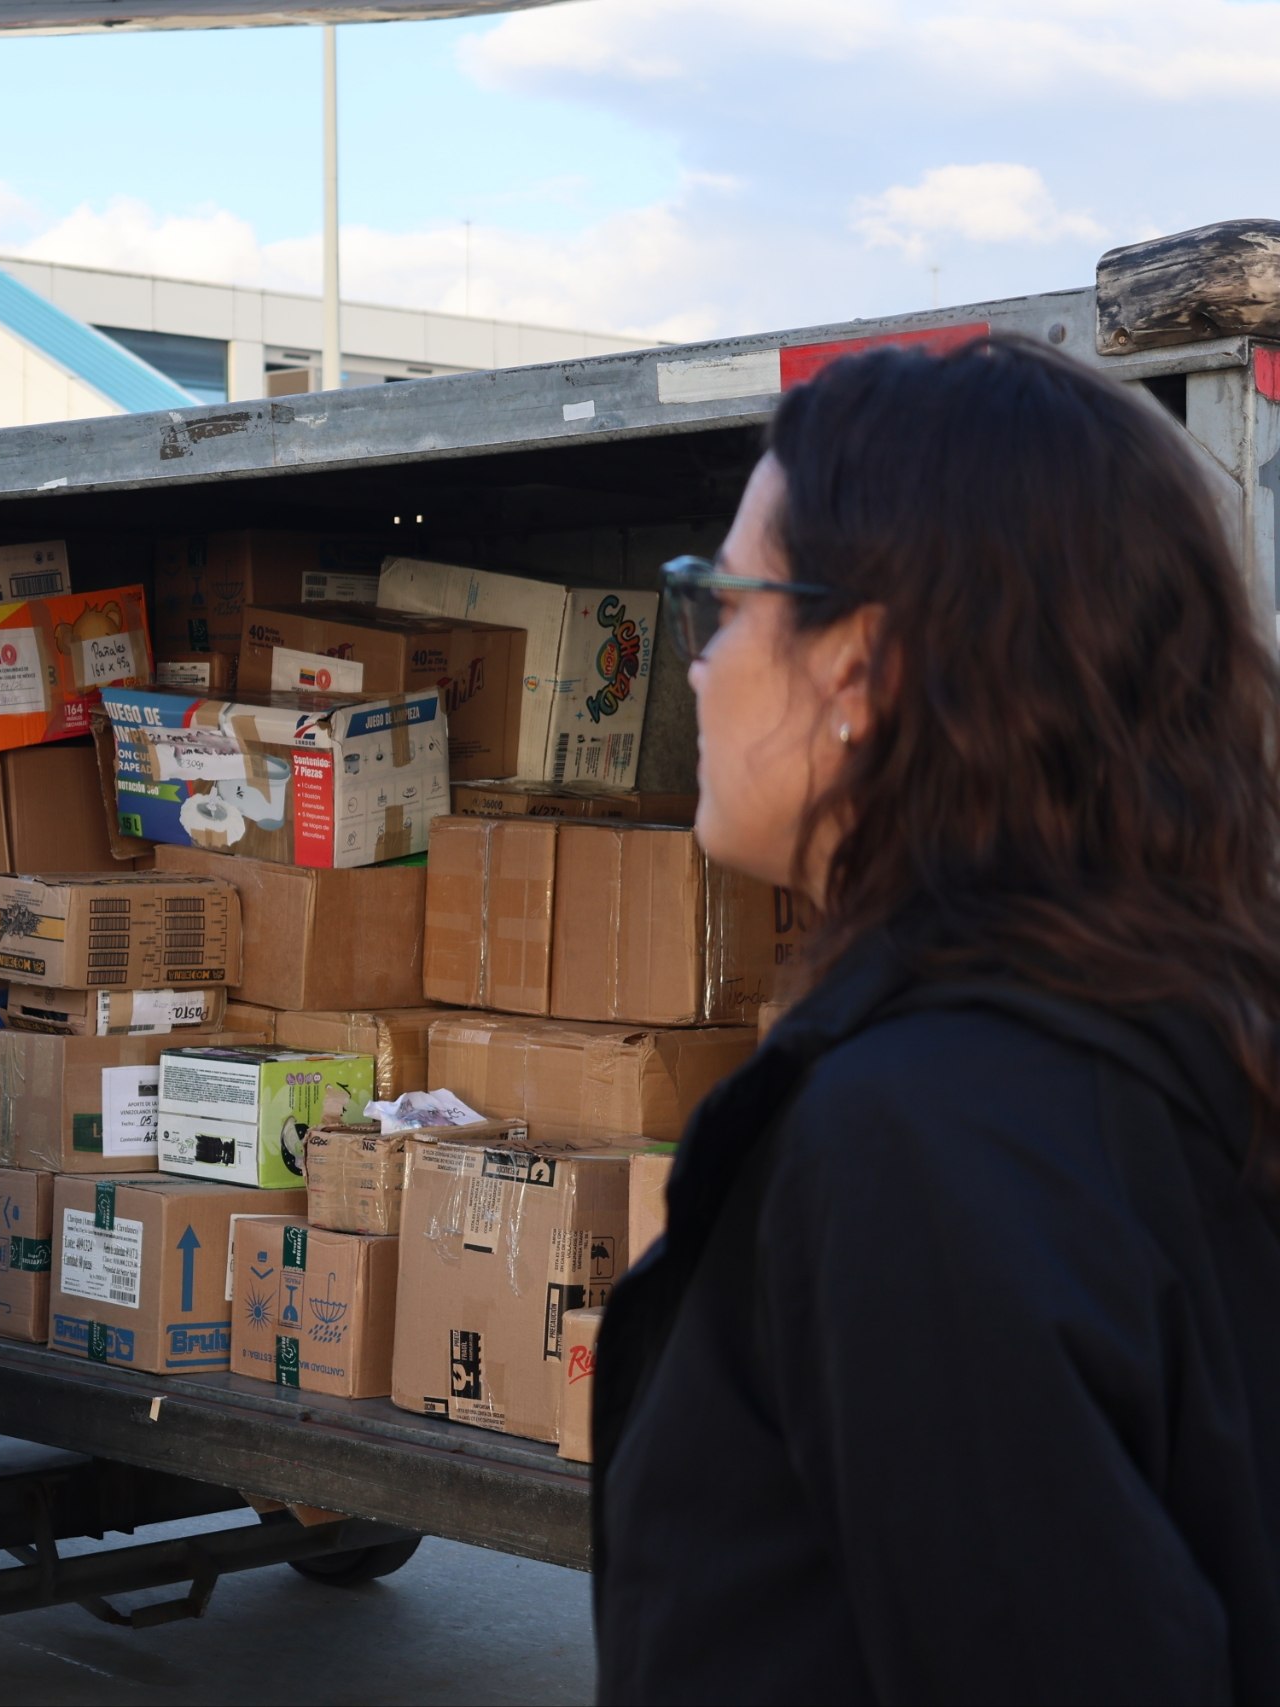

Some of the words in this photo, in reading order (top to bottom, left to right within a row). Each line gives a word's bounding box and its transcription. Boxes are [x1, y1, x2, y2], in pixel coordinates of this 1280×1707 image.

[249, 624, 264, 641] 40
[91, 640, 127, 660] Pañales
[412, 651, 427, 665] 40
[144, 706, 163, 726] DE
[365, 715, 384, 728] JUEGO
[118, 750, 132, 760] ON
[293, 755, 331, 768] Contenido:
[294, 766, 300, 776] 7
[300, 767, 323, 779] Piezas
[549, 1303, 558, 1339] PRECAUCIÓN
[171, 1328, 230, 1354] Brulu
[248, 1351, 272, 1363] ESTIBA:
[311, 1364, 344, 1377] CANTIDAD
